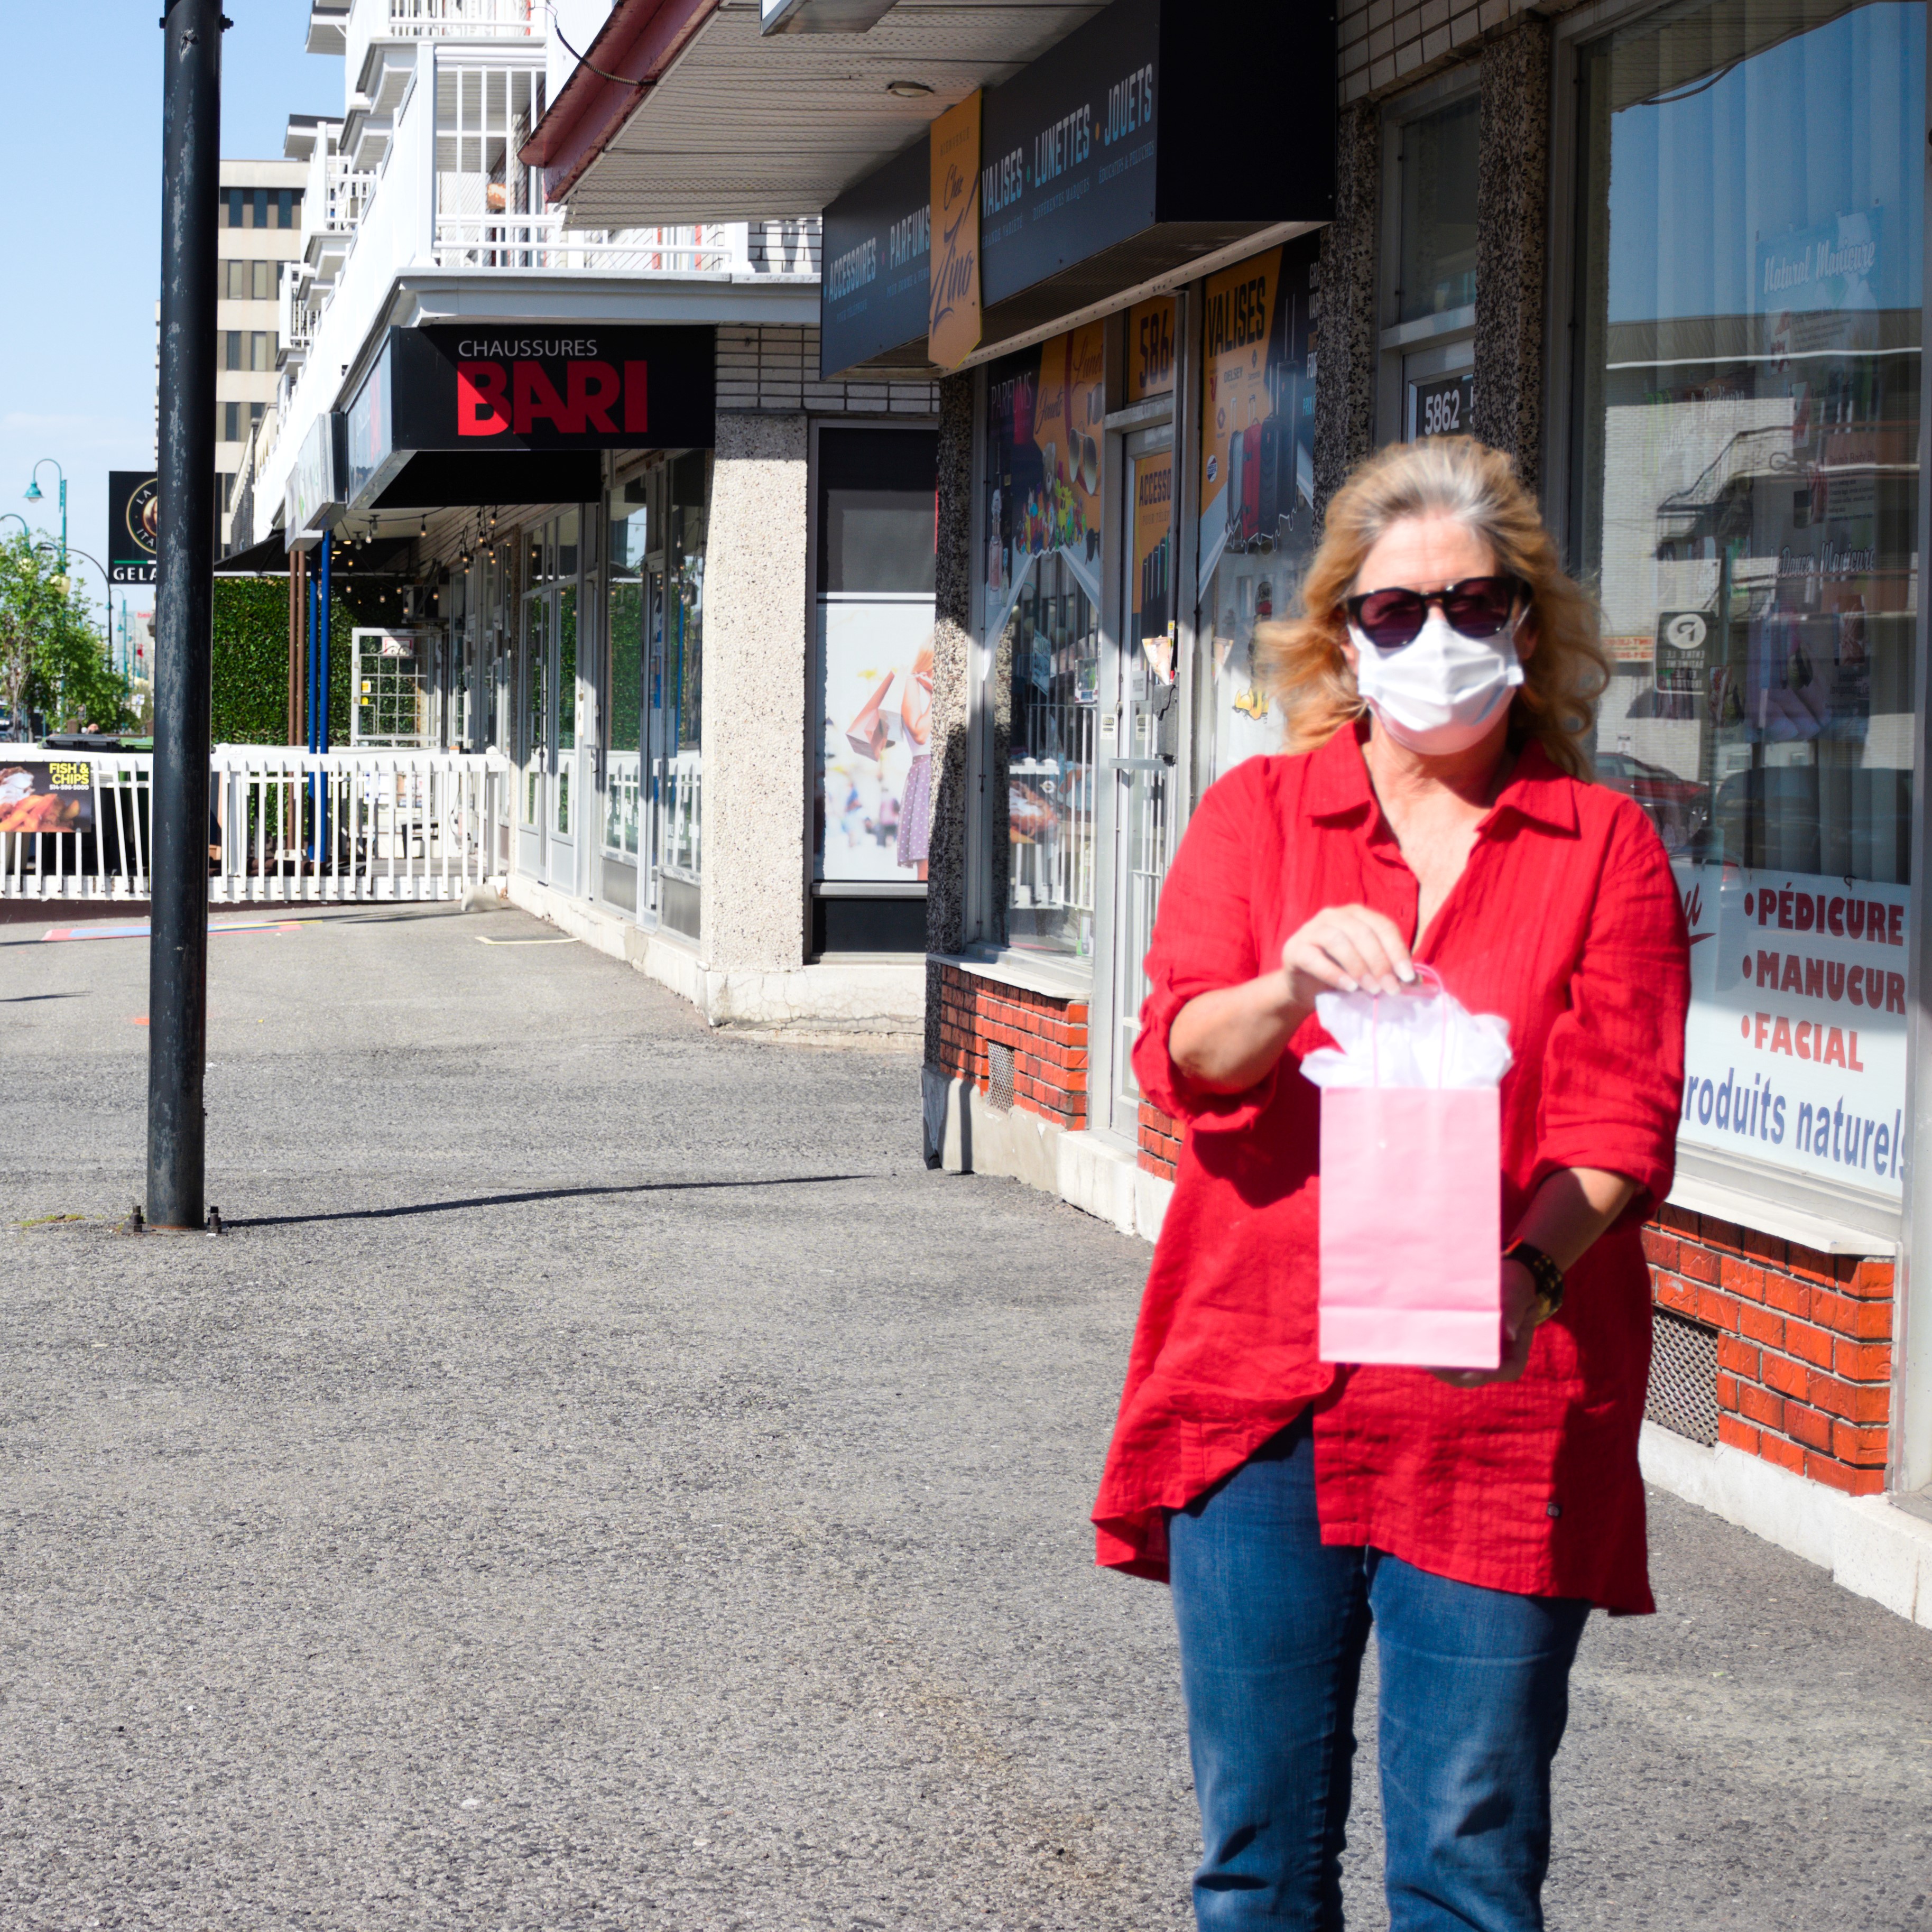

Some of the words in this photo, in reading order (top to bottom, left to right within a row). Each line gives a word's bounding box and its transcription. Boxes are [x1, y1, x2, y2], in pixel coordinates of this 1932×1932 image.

[982, 147, 1023, 219] VALISES
[1034, 103, 1090, 188] LUNETTES
[1104, 63, 1153, 147] JOUETS
[1130, 140, 1154, 167] PELUCHES
[1065, 177, 1090, 203] MARQUES
[828, 237, 876, 304] ACCESSOIRES
[890, 205, 930, 271] PARFUMS
[1763, 245, 1810, 295] Natural
[1816, 236, 1875, 282] Manicure
[1207, 276, 1265, 358] VALISES
[458, 339, 598, 357] CHAUSSURES
[457, 360, 648, 436] BARI
[991, 372, 1032, 421] PARFUMS
[1424, 389, 1460, 435] 5862
[136, 489, 152, 505] LA
[49, 762, 77, 774] FISH
[79, 762, 89, 774] &
[51, 773, 89, 785] CHIPS
[1758, 882, 1903, 947] PÉDICURE
[1756, 950, 1906, 1015] MANUCUR
[1754, 1011, 1863, 1073] FACIAL
